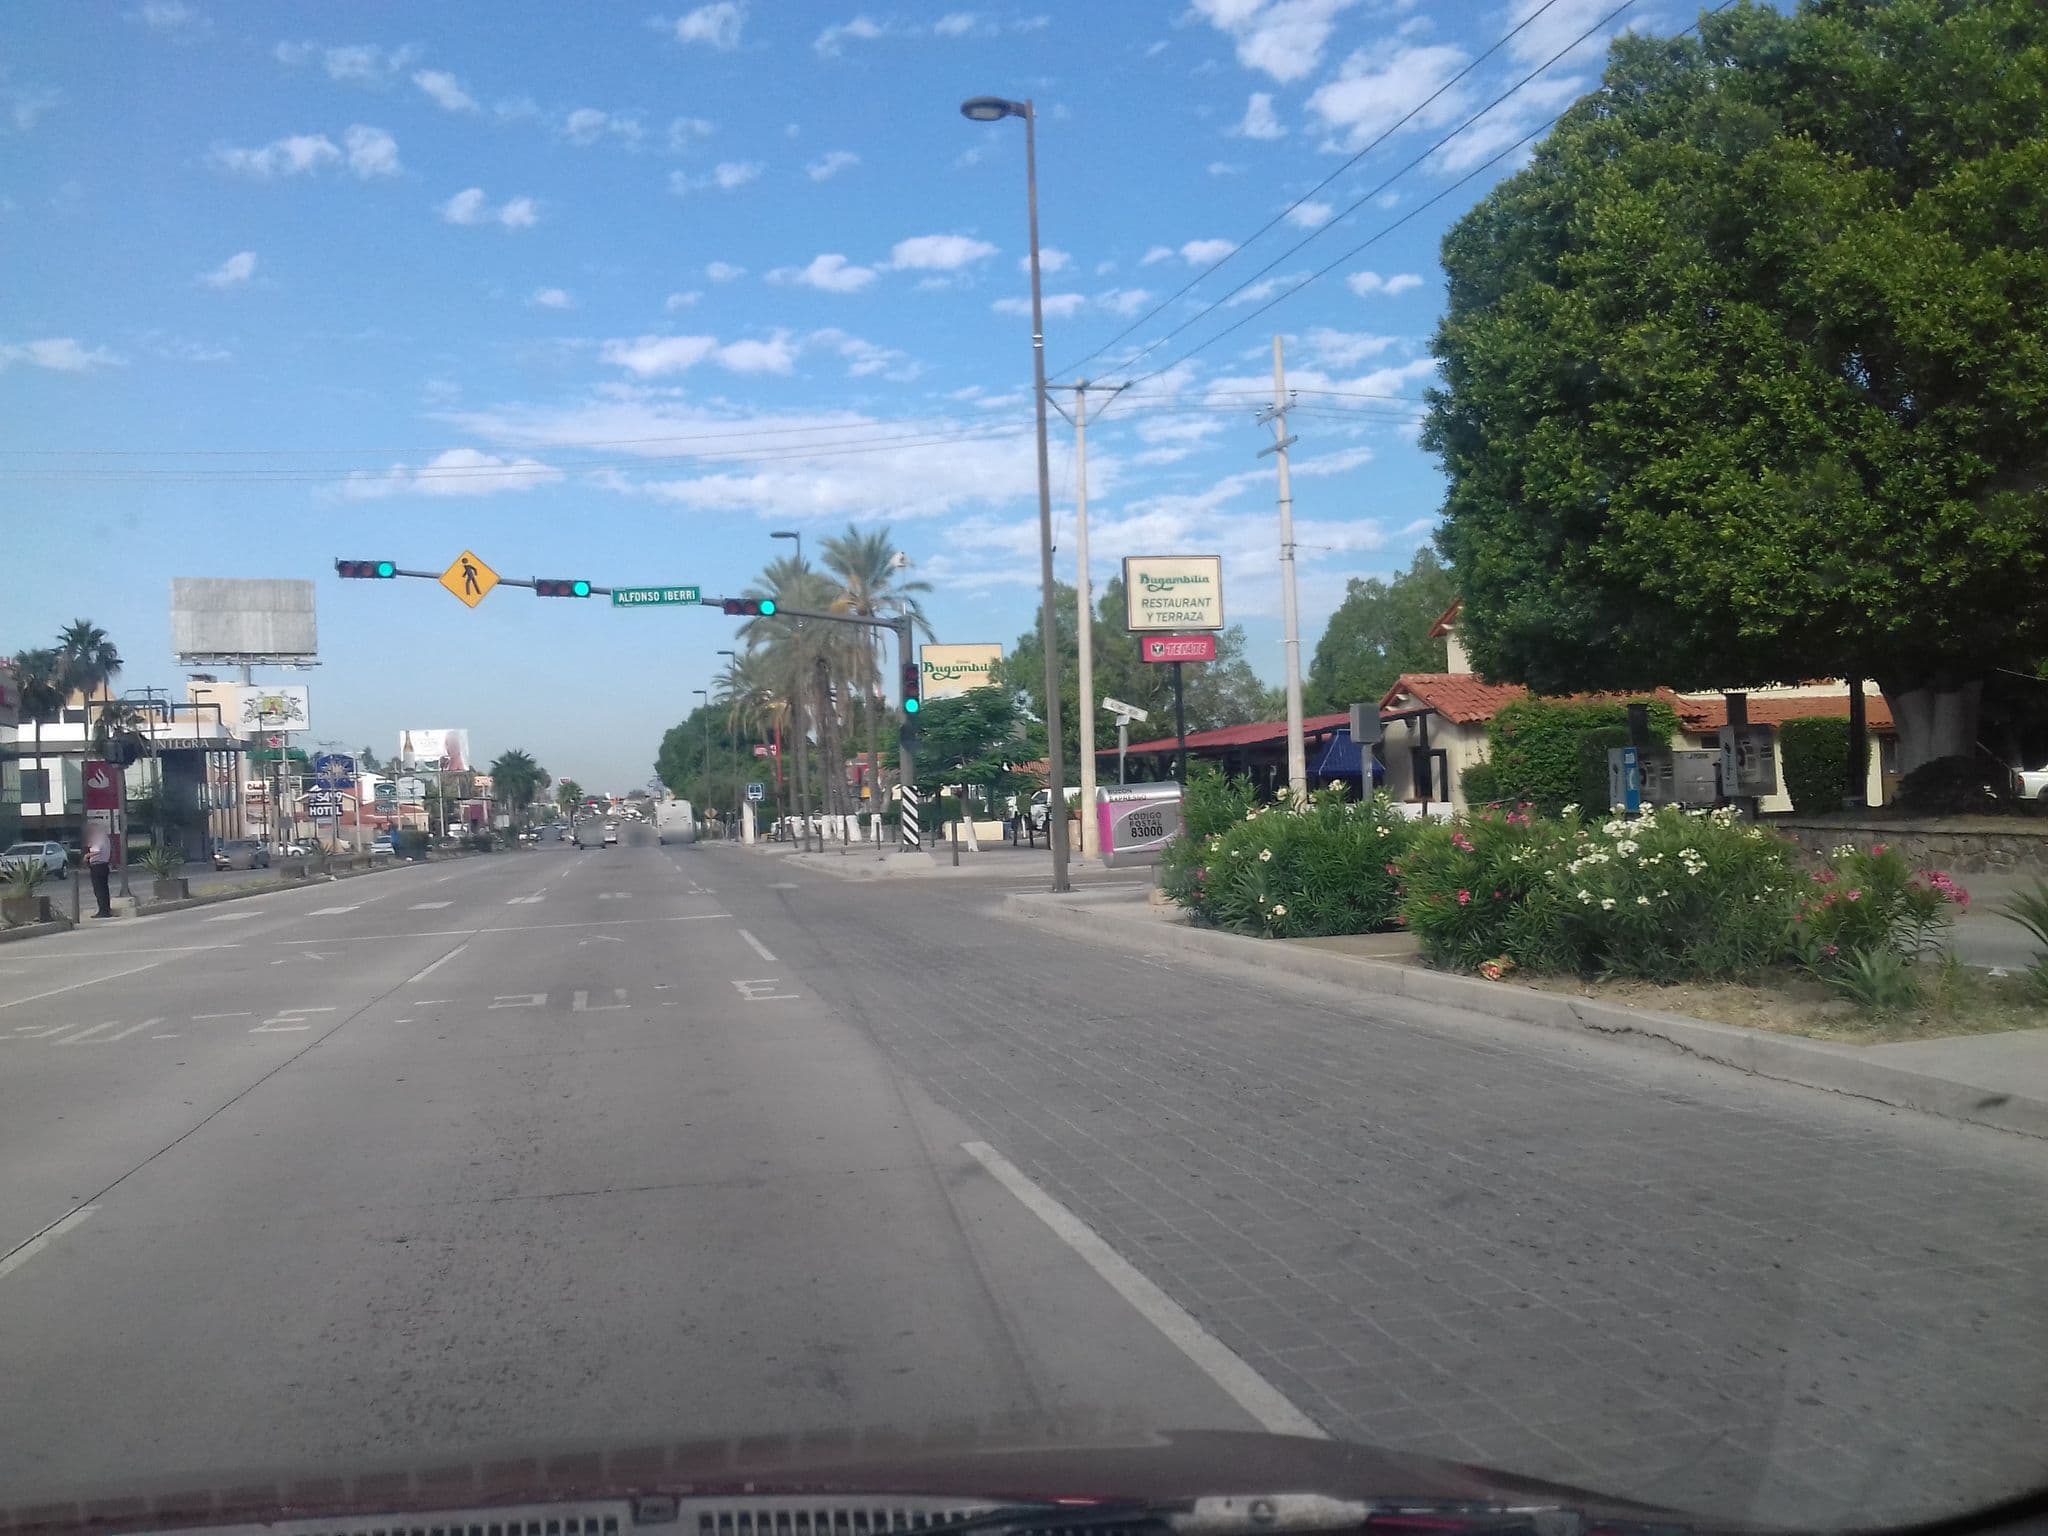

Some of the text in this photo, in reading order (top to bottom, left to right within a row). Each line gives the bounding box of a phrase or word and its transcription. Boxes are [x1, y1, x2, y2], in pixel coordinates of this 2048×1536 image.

[1139, 573, 1210, 592] Bugambilia
[618, 590, 696, 603] ALFONSO IBERRI
[1141, 598, 1211, 608] RESTAURANT
[1146, 611, 1204, 622] Y TERRAZA
[1166, 643, 1207, 655] TECATE
[923, 661, 991, 680] Bugambil
[1129, 812, 1162, 820] CODIGO
[1131, 826, 1163, 838] 83000
